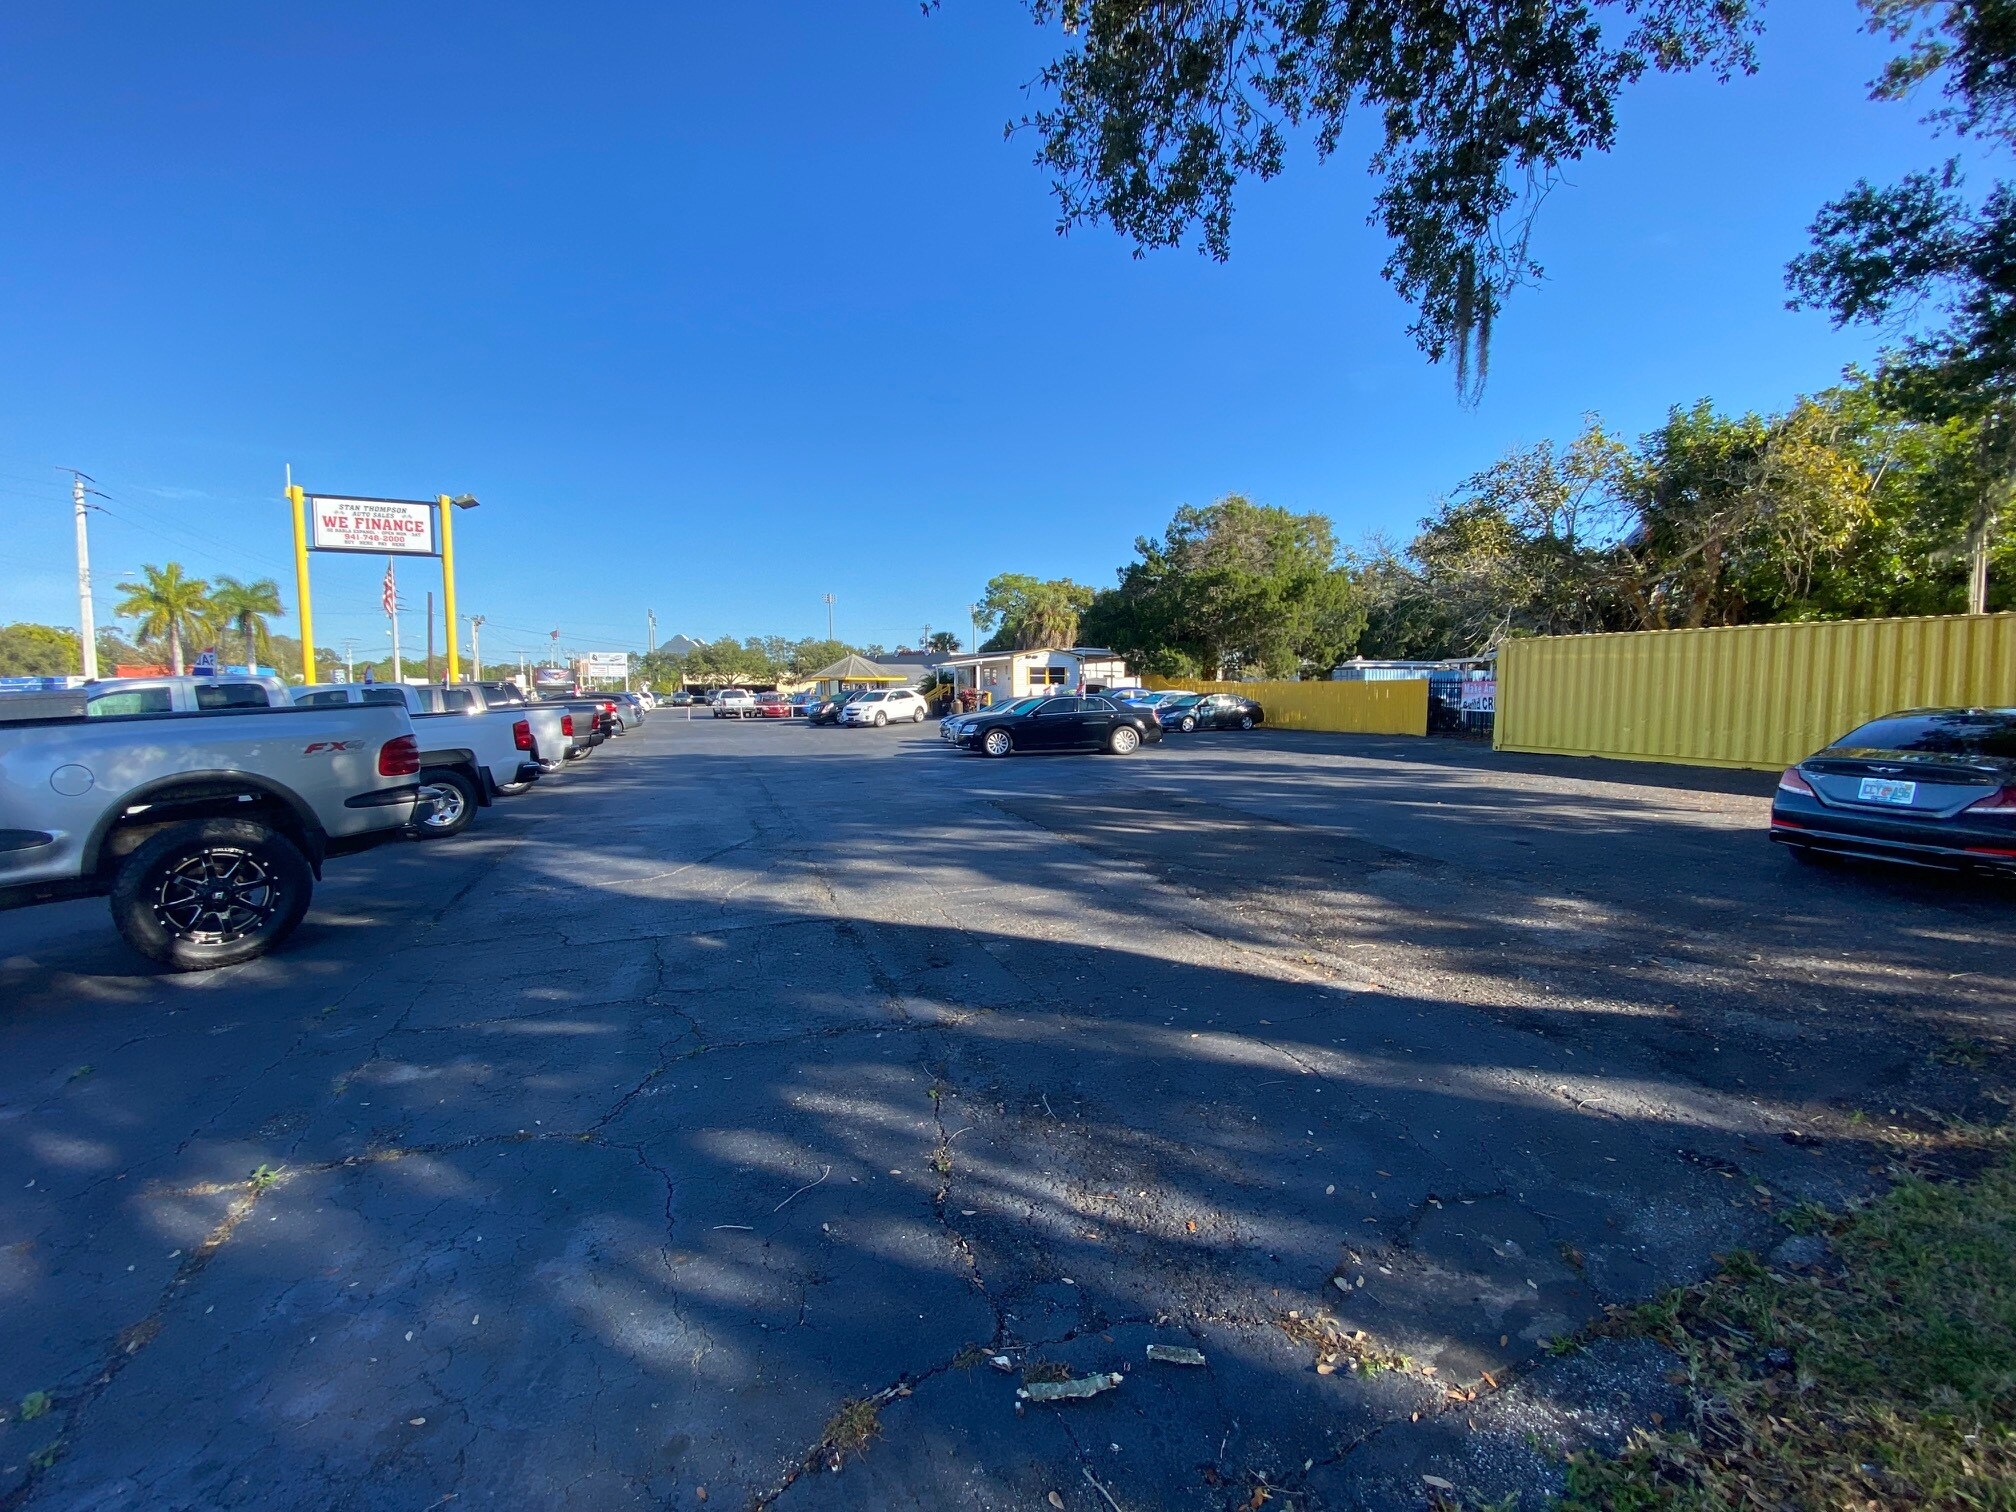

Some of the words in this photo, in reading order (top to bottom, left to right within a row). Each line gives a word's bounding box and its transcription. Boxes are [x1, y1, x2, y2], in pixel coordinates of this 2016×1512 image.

[364, 505, 407, 514] THOMPSON
[322, 515, 348, 528] WE
[355, 518, 424, 532] FINANCE
[344, 533, 405, 542] 941-748-2000
